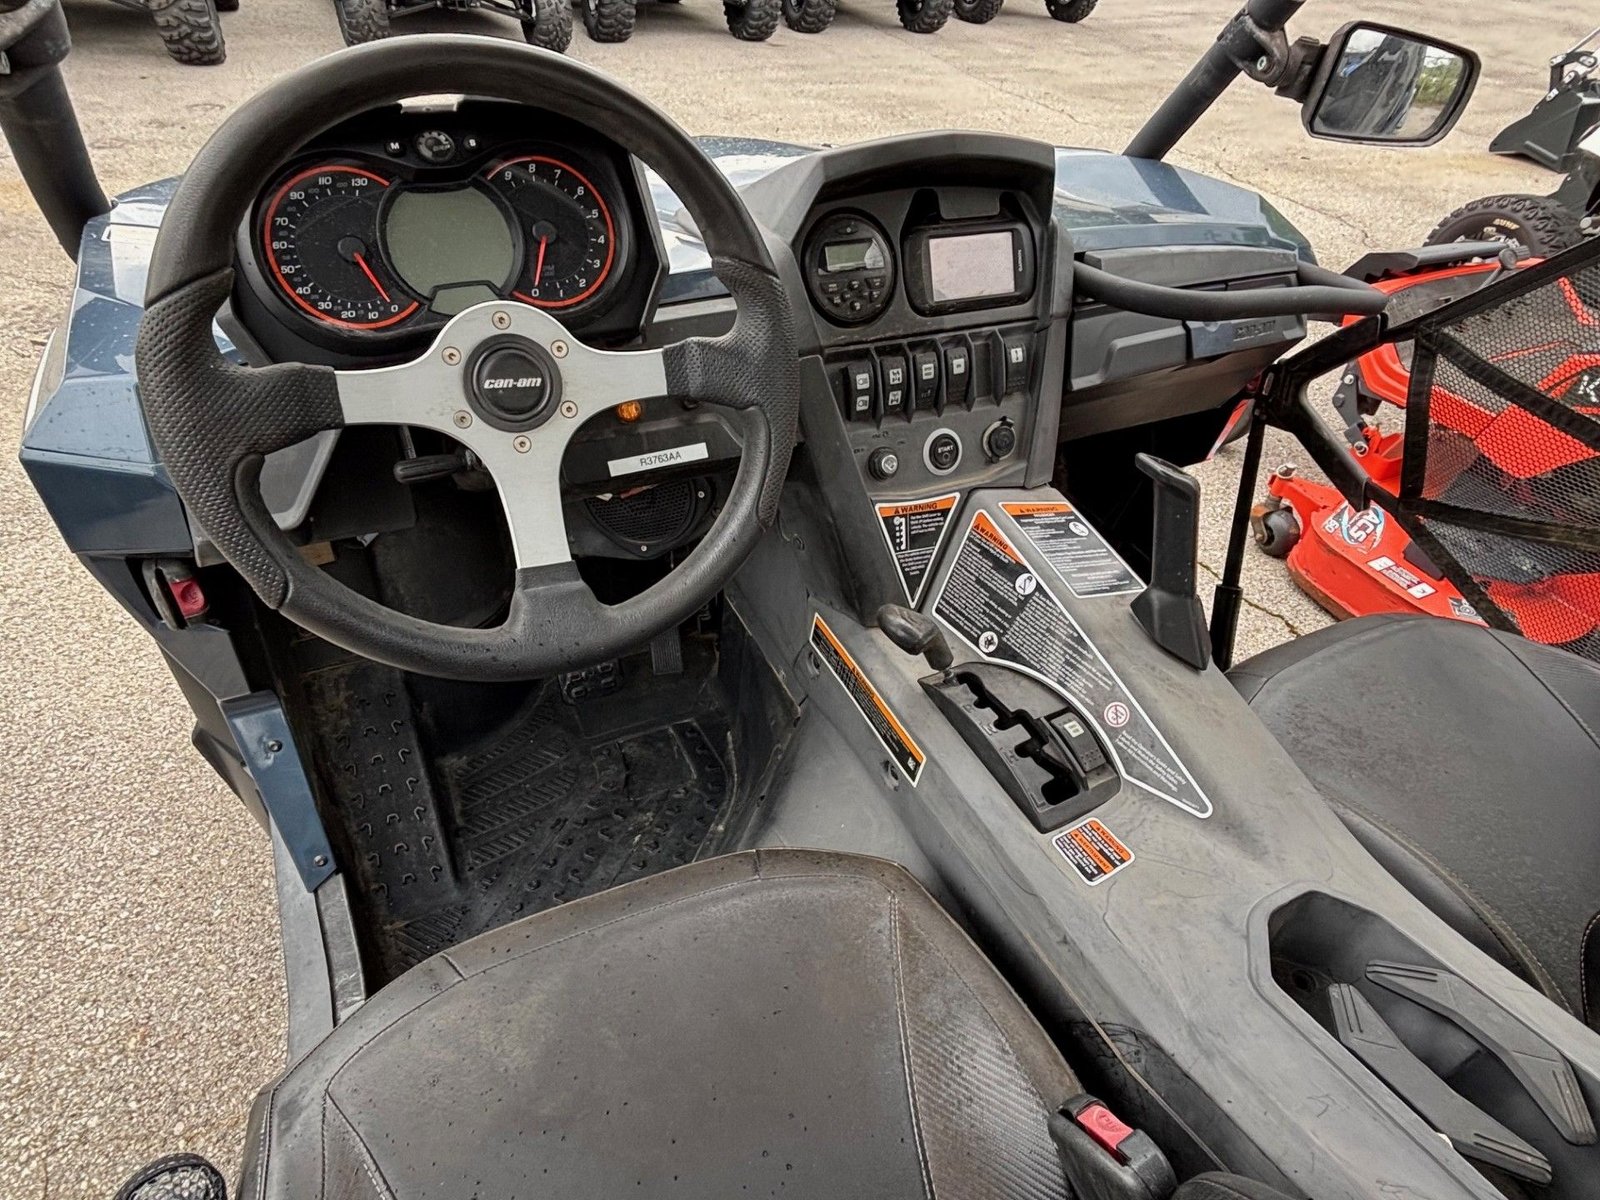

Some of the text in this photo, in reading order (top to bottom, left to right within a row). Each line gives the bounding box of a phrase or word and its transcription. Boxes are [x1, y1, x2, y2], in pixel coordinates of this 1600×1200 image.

[390, 142, 400, 150] M
[528, 163, 536, 173] 8
[504, 171, 512, 180] 9
[554, 169, 562, 179] 7
[318, 176, 332, 185] 110
[351, 177, 368, 186] 130
[289, 191, 305, 200] 90
[577, 186, 585, 196] 6
[591, 209, 599, 218] 5
[275, 217, 289, 226] 70
[597, 235, 605, 244] 4
[272, 241, 288, 250] 60
[593, 259, 600, 268] 3
[280, 265, 295, 274] 50
[579, 279, 587, 288] 2
[296, 286, 311, 295] 40
[531, 288, 539, 297] 0
[317, 301, 332, 310] 30
[390, 304, 399, 313] 0
[341, 310, 356, 319] 20
[368, 311, 379, 320] 10
[483, 377, 542, 389] can-am
[639, 451, 682, 467] R3763AA
[900, 502, 938, 514] WARNING
[979, 527, 1009, 550] WARNING
[1099, 829, 1124, 854] WARNING
